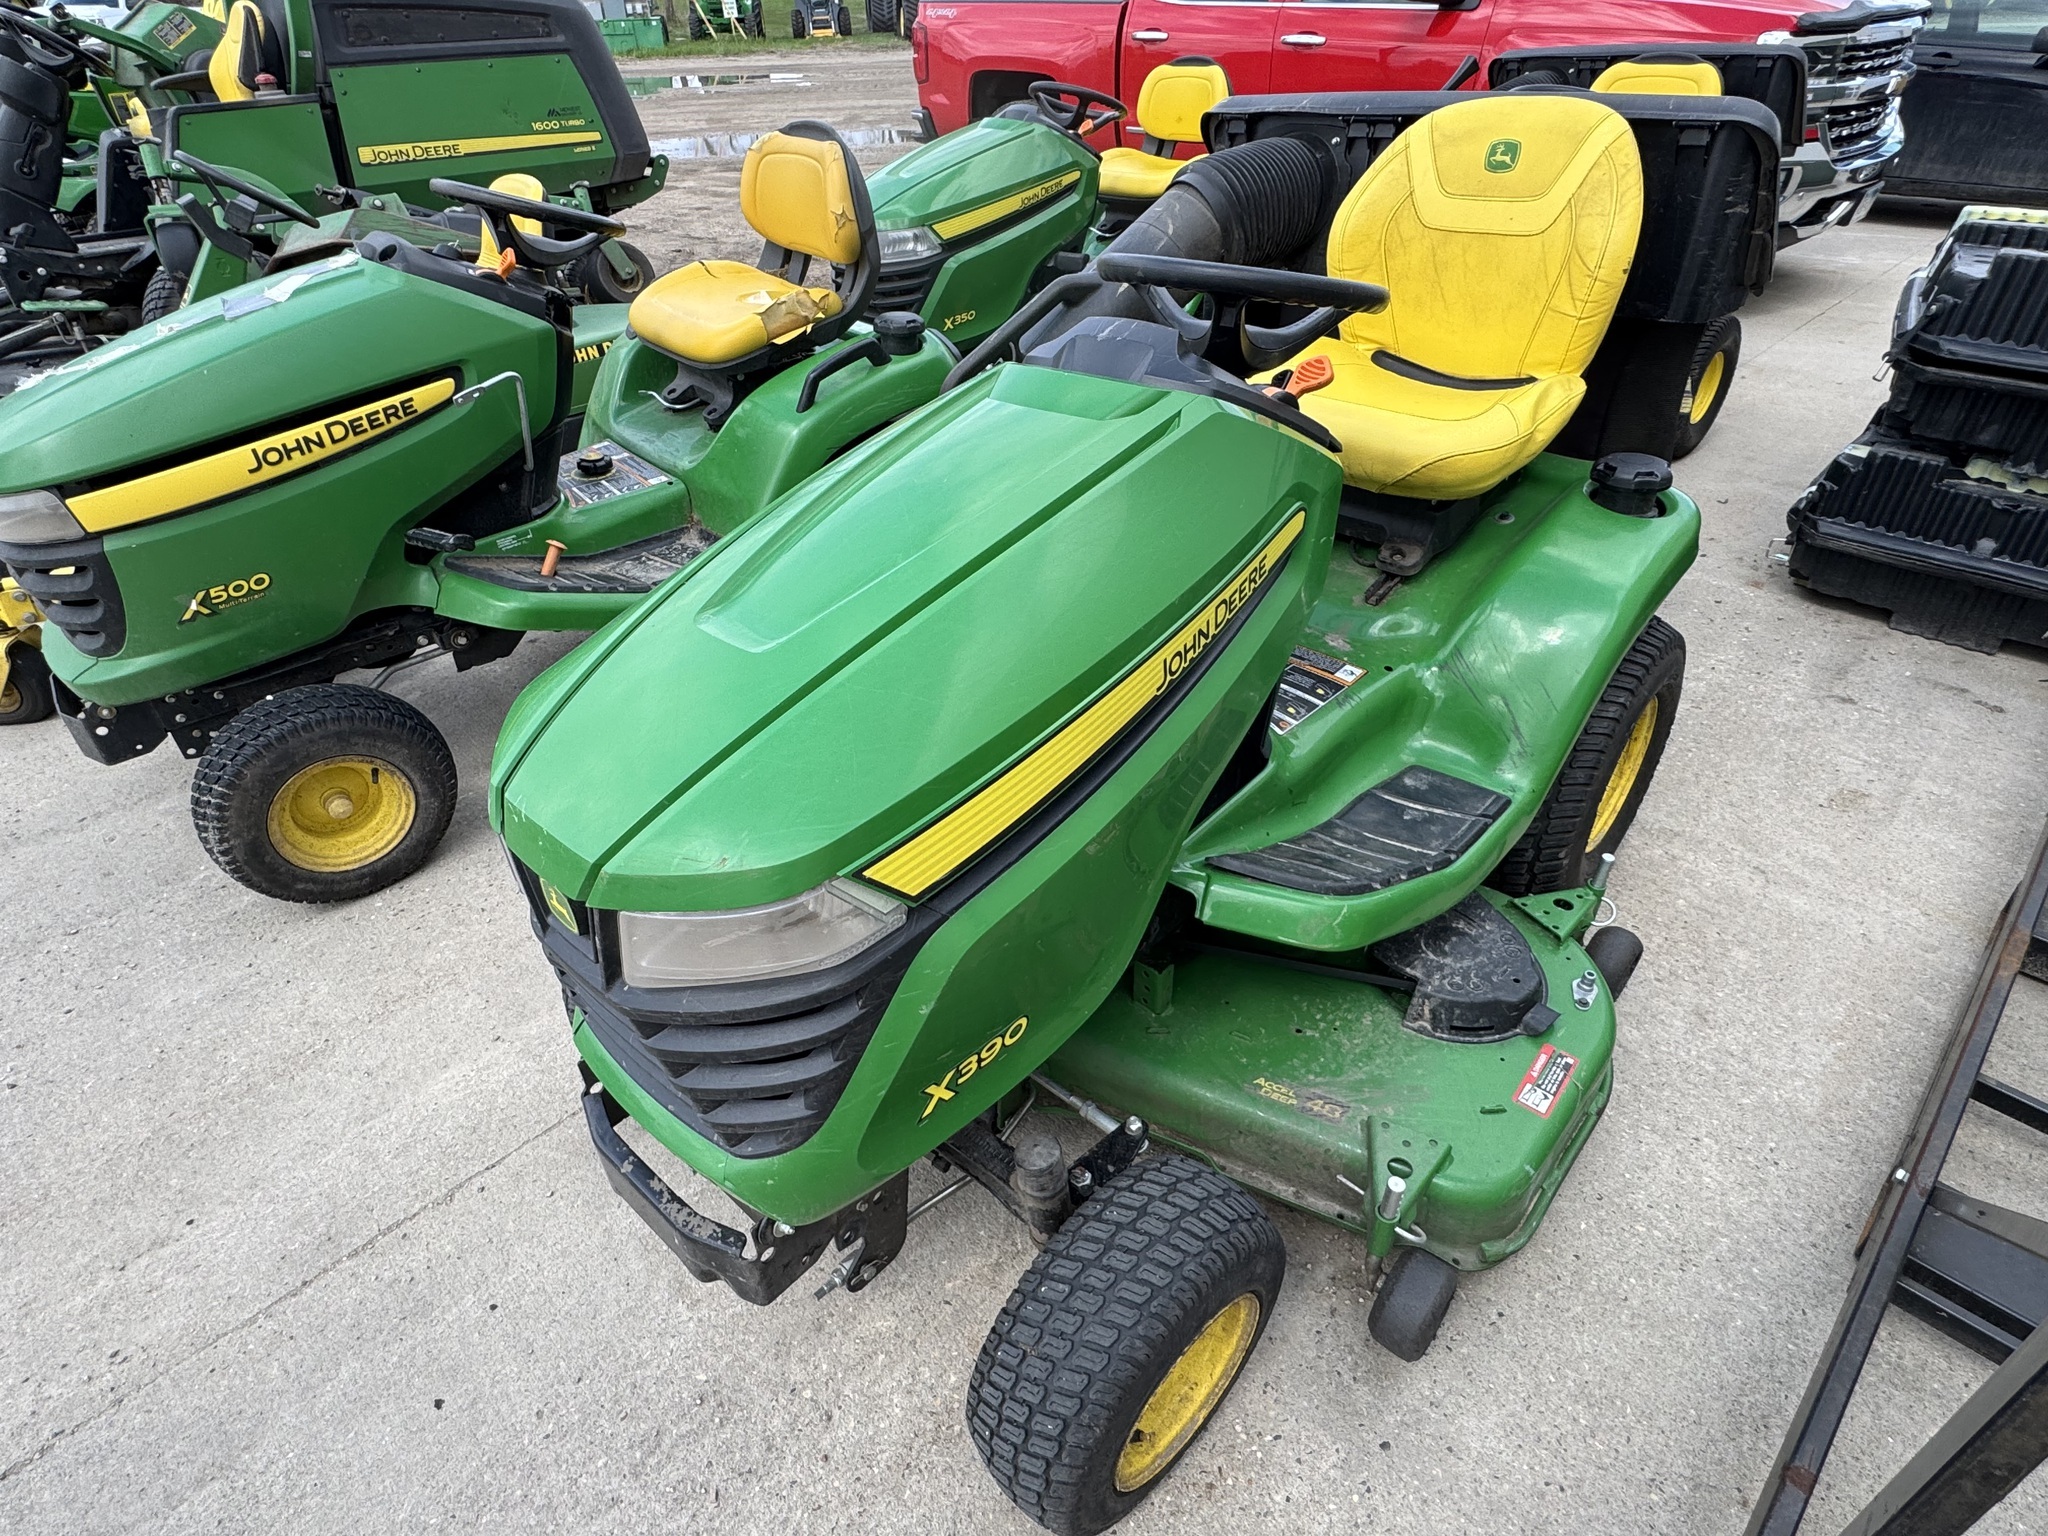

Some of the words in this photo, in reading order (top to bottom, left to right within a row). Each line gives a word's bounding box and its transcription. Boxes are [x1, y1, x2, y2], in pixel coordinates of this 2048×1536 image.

[531, 120, 560, 132] 1600
[560, 118, 586, 128] TURBO
[370, 148, 411, 163] JOHN
[411, 143, 463, 159] DEERE
[1019, 191, 1041, 209] JOHN
[1040, 179, 1064, 198] DEERE
[942, 310, 976, 331] X350
[247, 430, 327, 475] JOHN
[323, 396, 419, 445] DEERE
[180, 573, 271, 622] X500
[1155, 618, 1211, 694] JOHN
[1213, 553, 1269, 633] DEERE
[920, 1015, 1029, 1120] X390
[1252, 1077, 1297, 1098] ACCEL
[1259, 1087, 1298, 1106] DEEP
